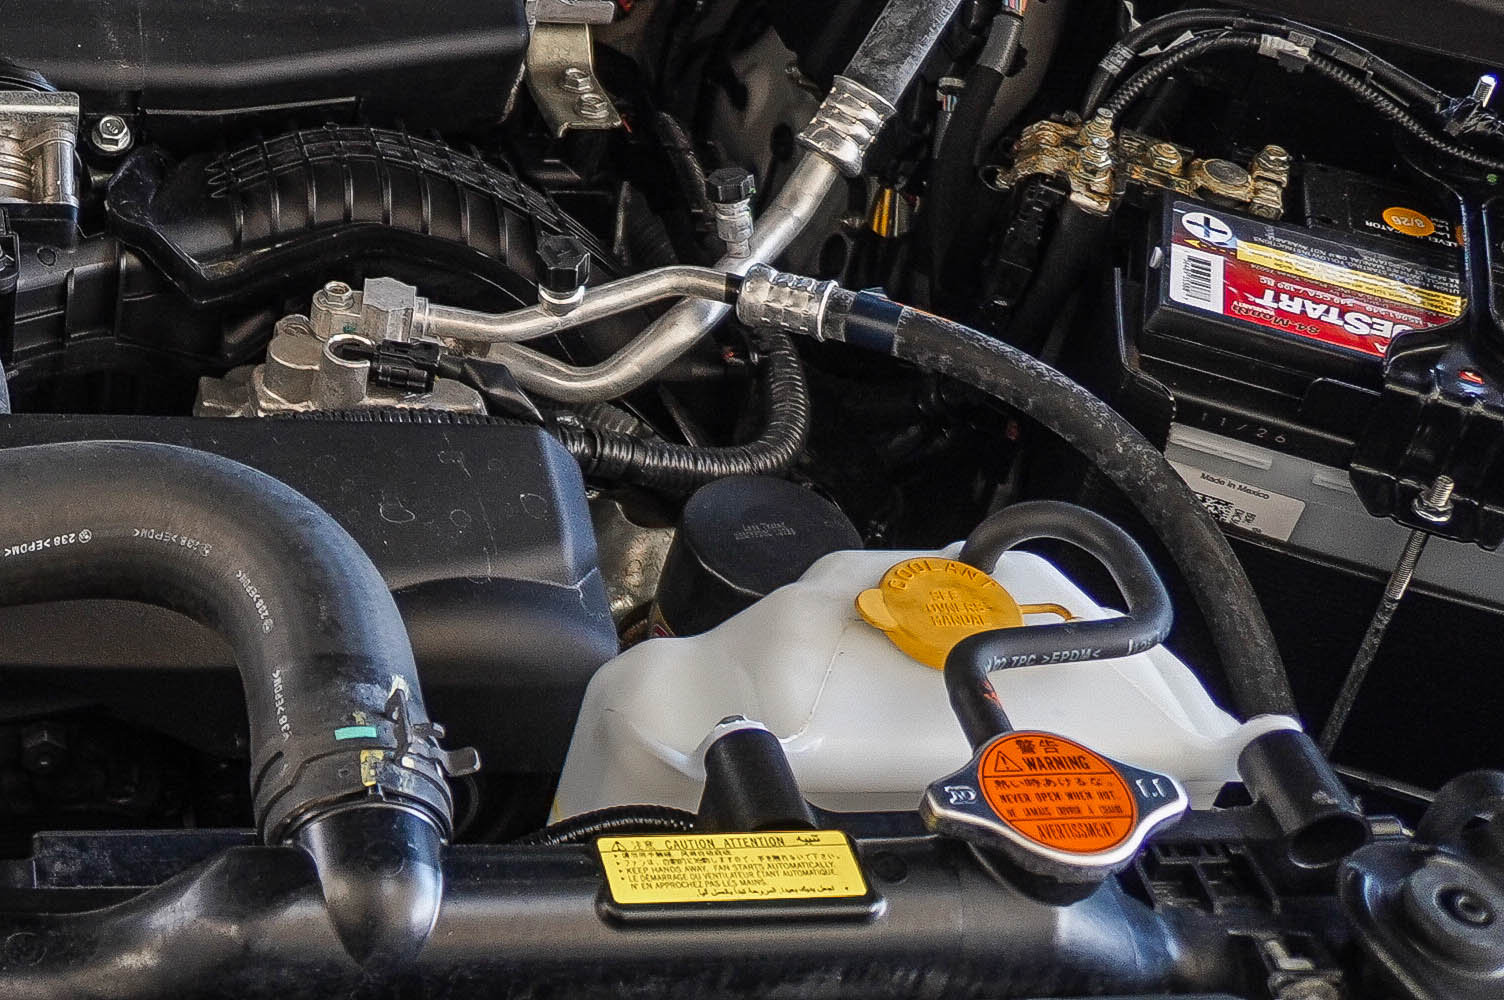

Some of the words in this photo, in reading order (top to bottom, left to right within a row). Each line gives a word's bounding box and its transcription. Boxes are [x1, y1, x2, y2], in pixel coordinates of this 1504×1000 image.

[1200, 472, 1226, 486] Made
[1227, 480, 1236, 490] in
[1237, 484, 1270, 500] Mexico
[53, 532, 76, 546] 238
[888, 560, 996, 591] COOLANT
[1022, 755, 1091, 771] WARNING
[999, 792, 1032, 804] NEVER
[1035, 791, 1061, 803] OPEN
[1064, 791, 1092, 801] WHEN
[664, 838, 716, 851] CAUTION
[723, 836, 785, 849] ATTENTION
[626, 866, 649, 875] KEEP
[651, 865, 682, 874] HANDS
[713, 863, 730, 872] FAN
